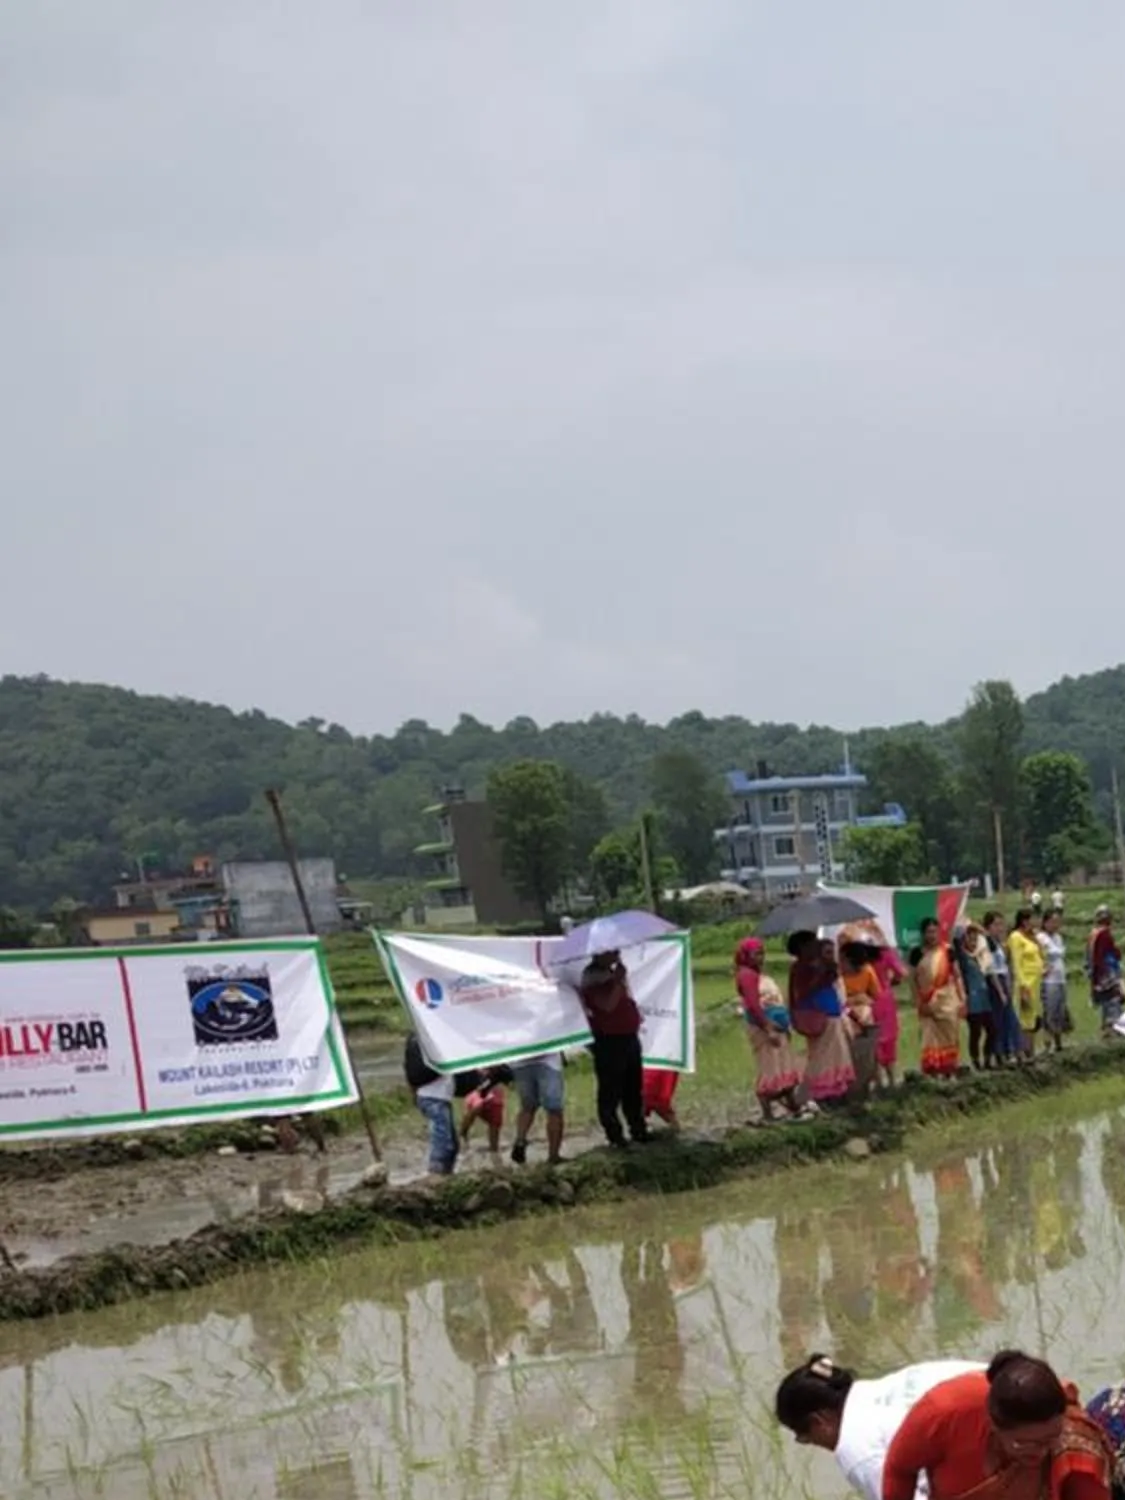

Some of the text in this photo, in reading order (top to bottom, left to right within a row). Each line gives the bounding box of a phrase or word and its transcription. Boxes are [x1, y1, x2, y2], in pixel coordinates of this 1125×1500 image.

[57, 1020, 107, 1052] BAR
[158, 1066, 195, 1083] MOUNT
[198, 1062, 242, 1079] KAILASH
[244, 1058, 283, 1075] RESORT
